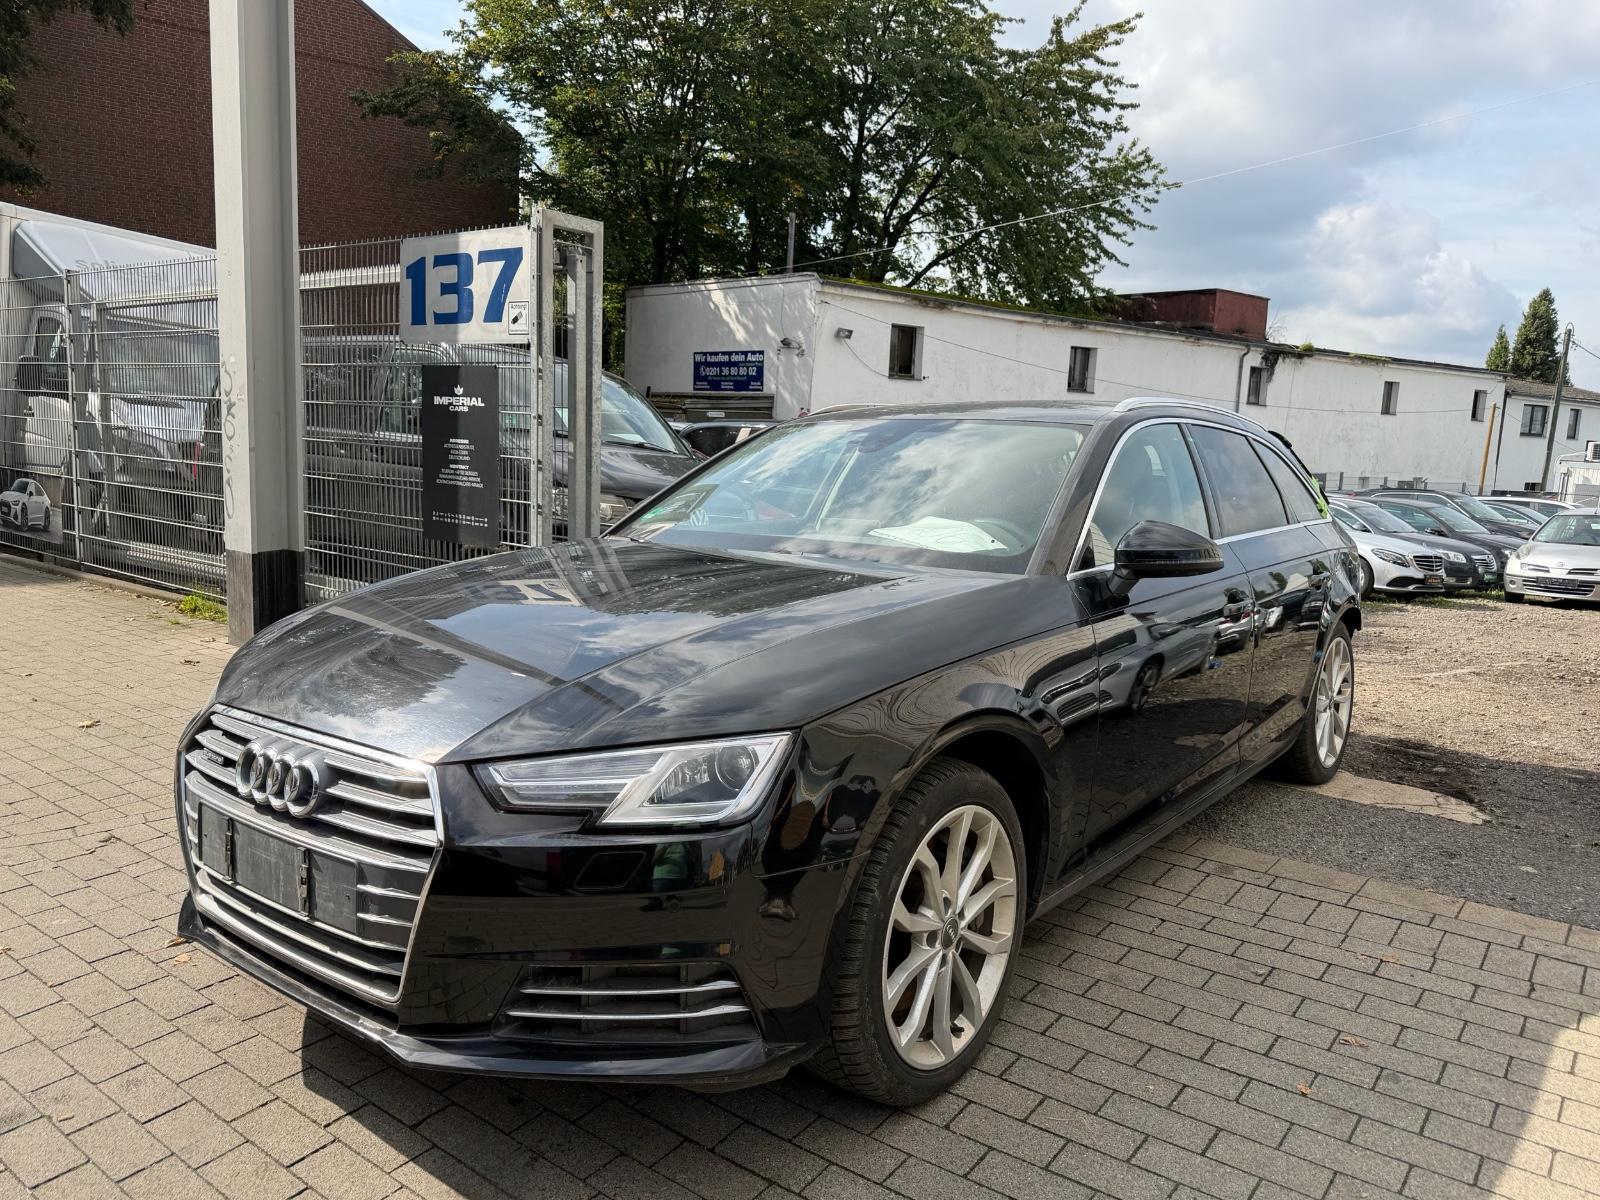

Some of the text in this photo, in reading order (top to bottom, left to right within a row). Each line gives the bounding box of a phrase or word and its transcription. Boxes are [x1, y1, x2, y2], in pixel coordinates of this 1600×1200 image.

[406, 247, 523, 325] 137
[695, 352, 763, 362] Wir kaufen dein Auto
[748, 366, 757, 376] 02
[433, 396, 485, 407] IMPERIAL
